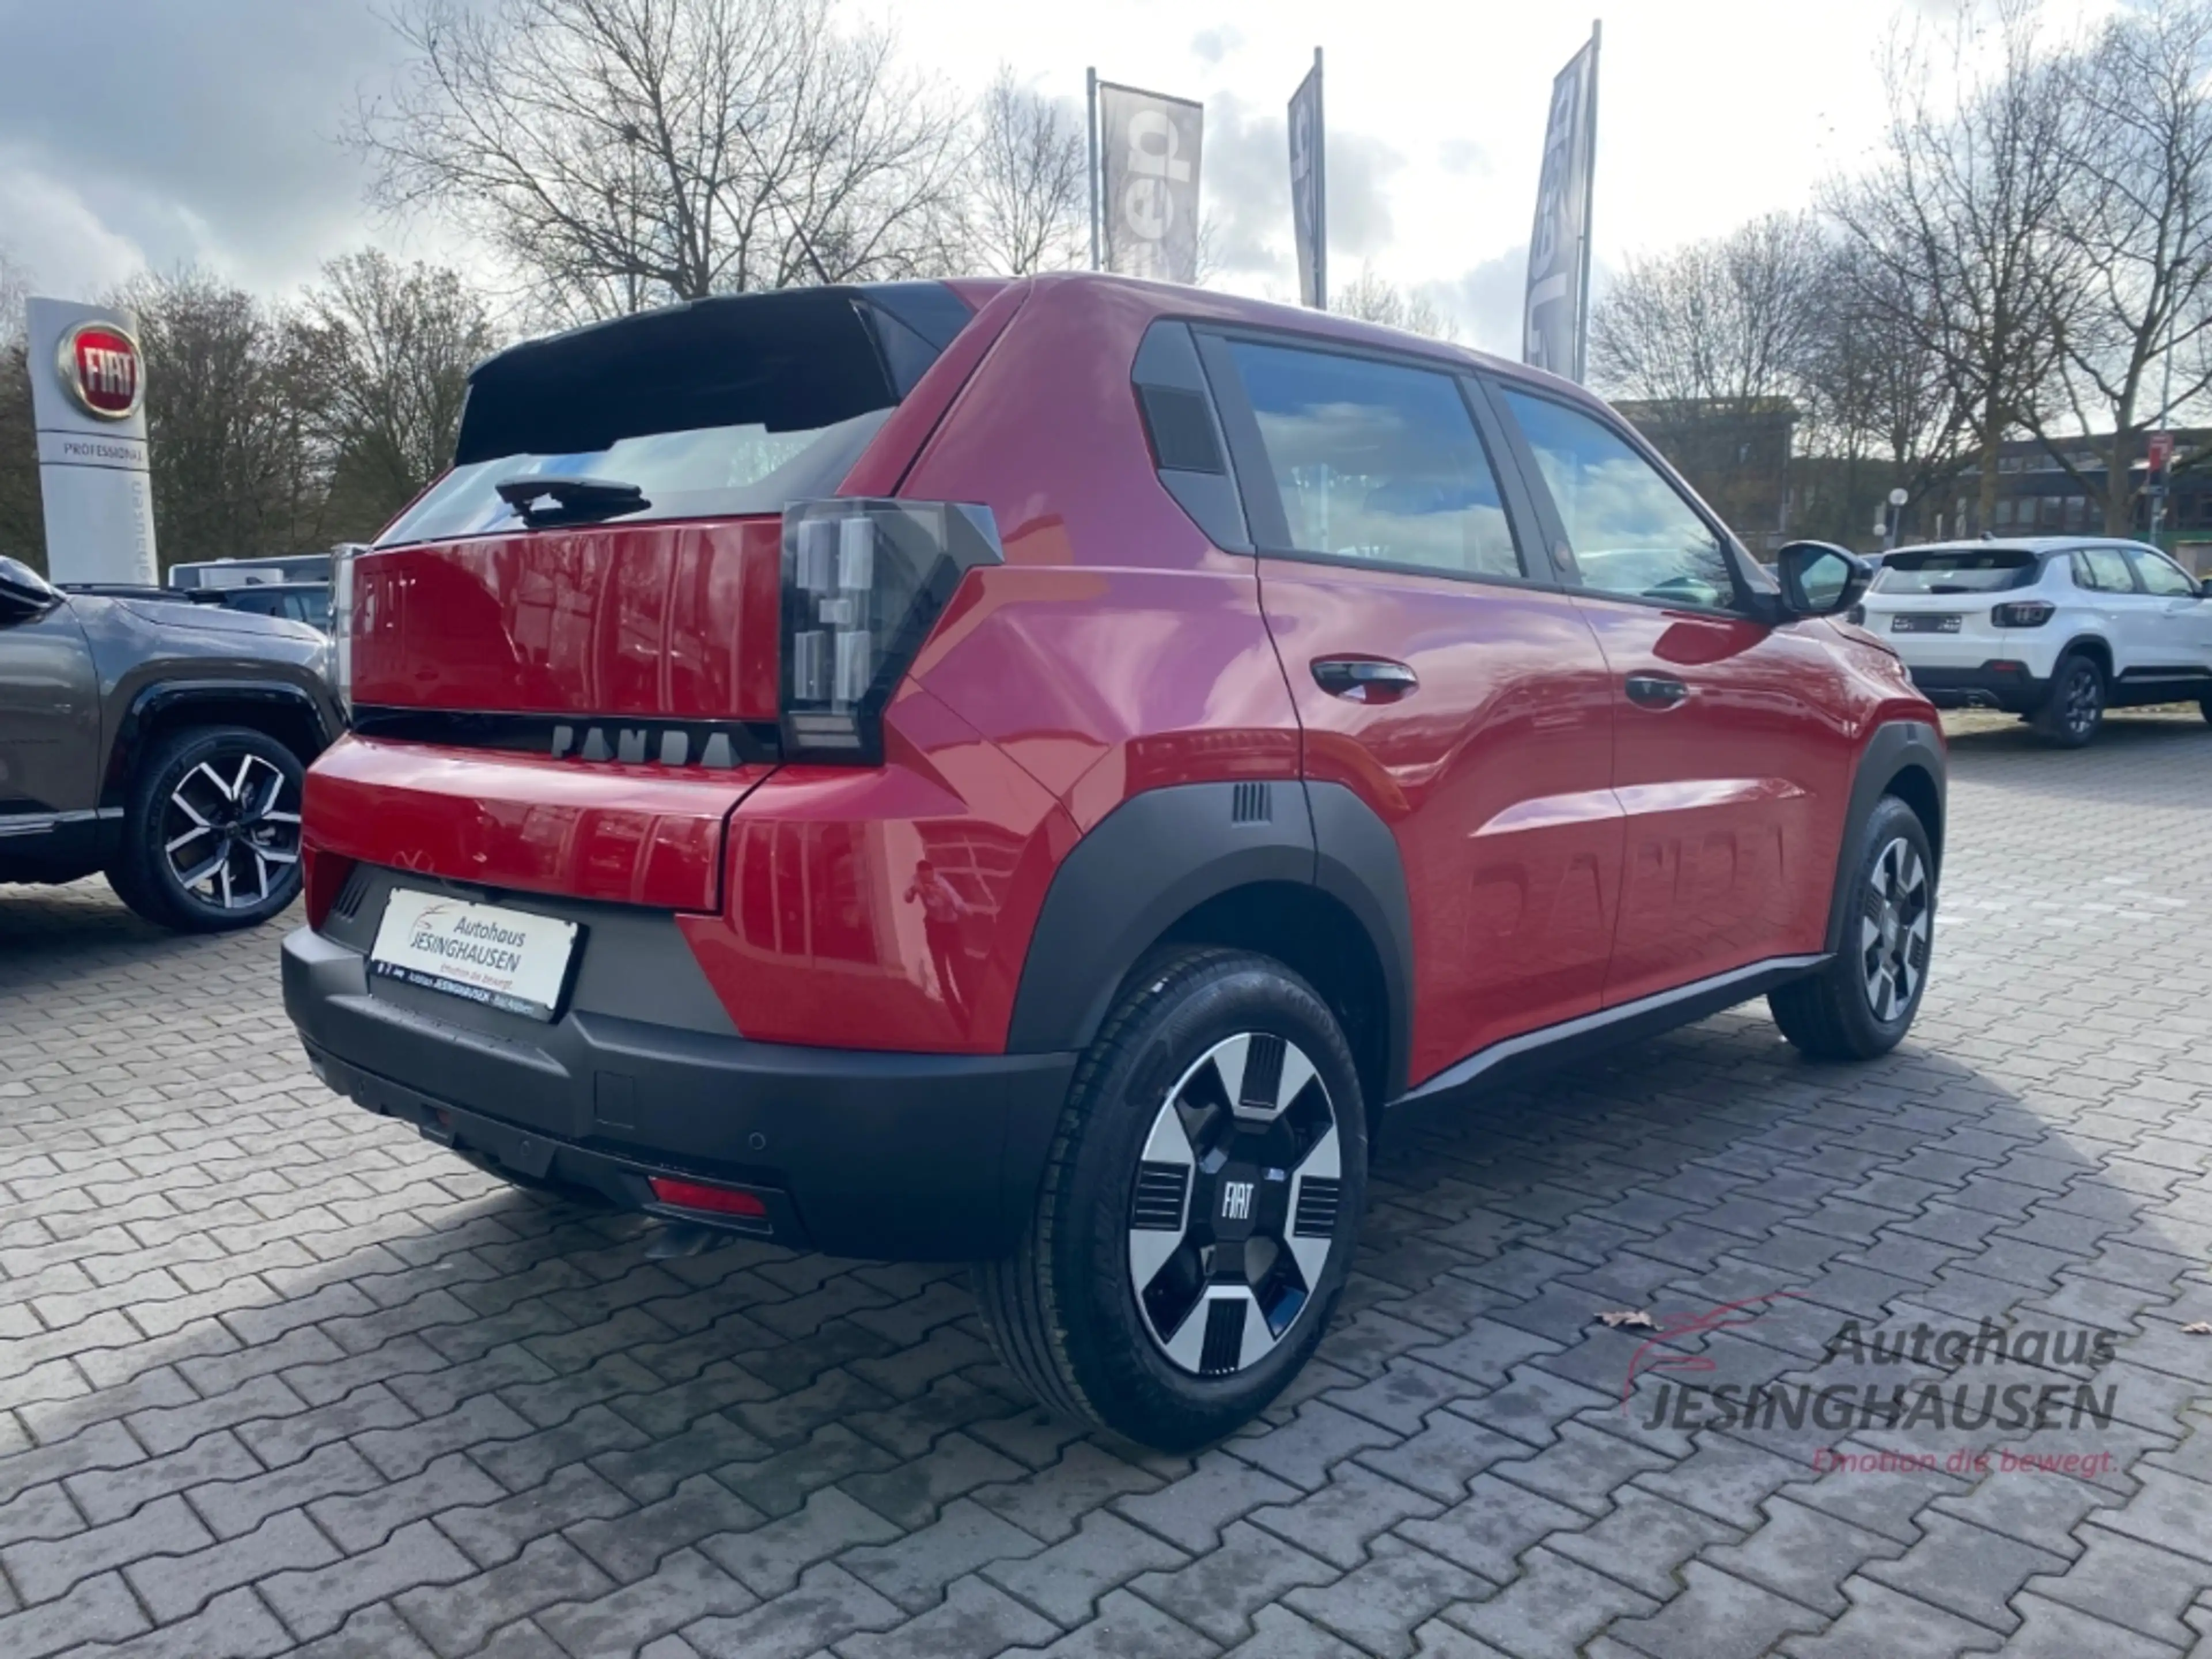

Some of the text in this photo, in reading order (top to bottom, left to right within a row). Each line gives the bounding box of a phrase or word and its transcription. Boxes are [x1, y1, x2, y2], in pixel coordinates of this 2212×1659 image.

[84, 347, 131, 396] FIAT
[63, 442, 143, 461] PROFESSIONAL
[551, 725, 743, 768] PANDA
[453, 916, 525, 947] Autohaus
[410, 931, 521, 972] JESINGHAUSEN
[1222, 1181, 1254, 1219] FIAT
